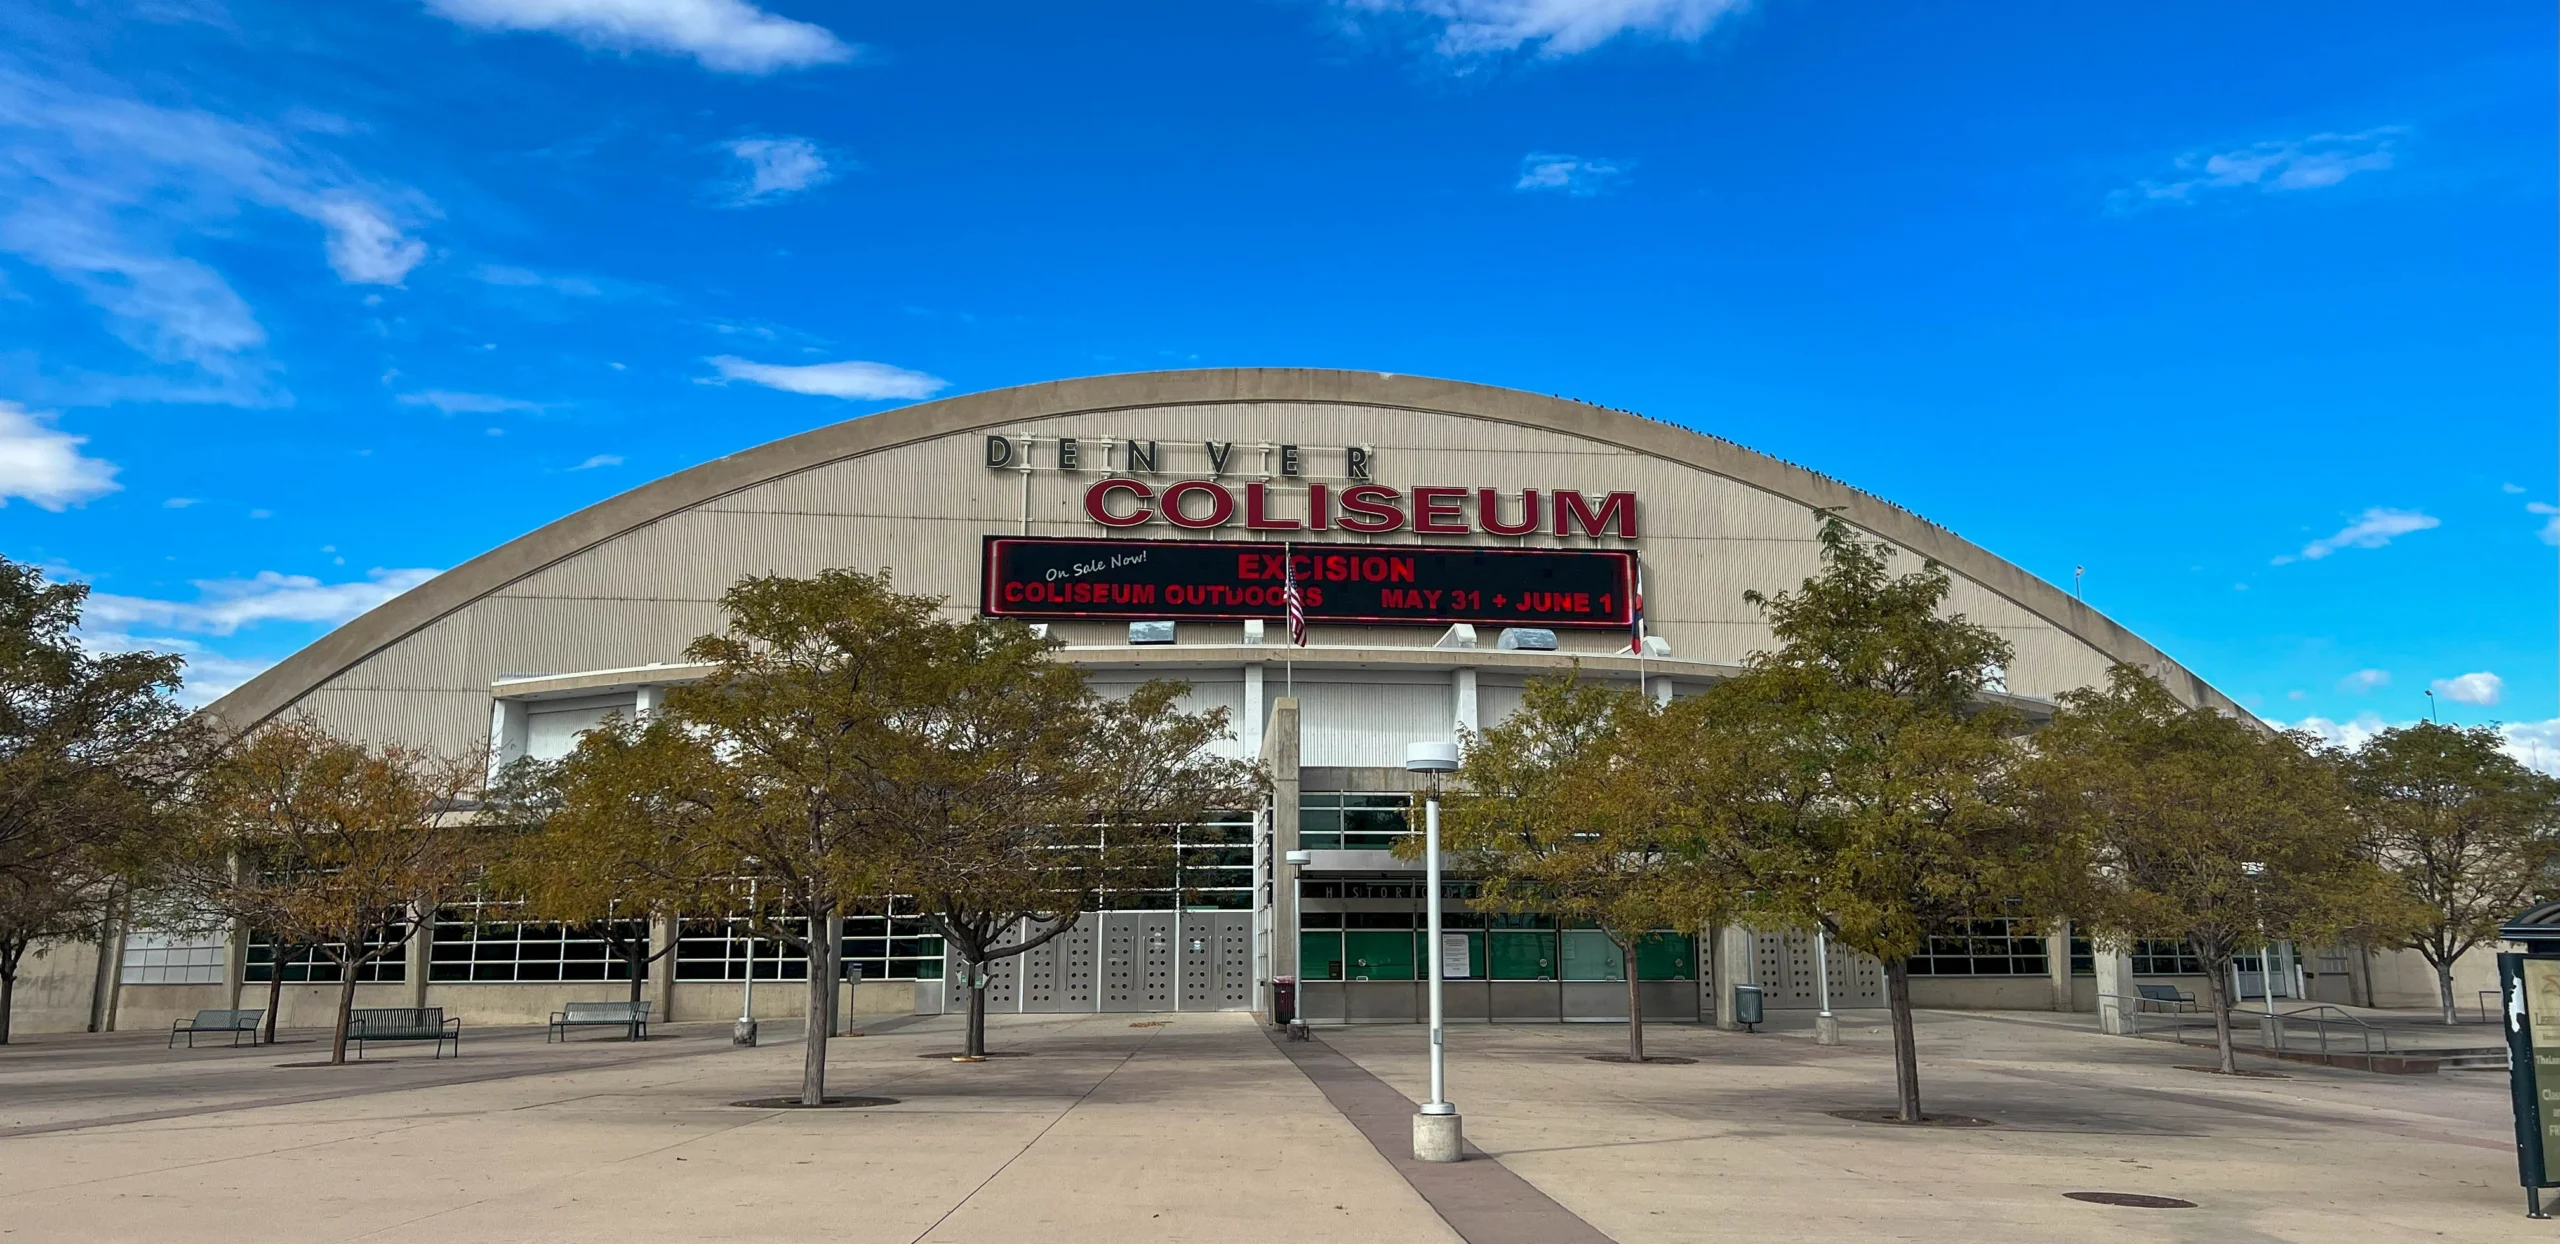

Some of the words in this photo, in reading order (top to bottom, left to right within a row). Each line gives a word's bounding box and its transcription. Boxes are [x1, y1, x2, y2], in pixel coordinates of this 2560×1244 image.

[986, 434, 1369, 479] DENVER
[1084, 477, 1638, 539] COLISEUM
[1046, 568, 1069, 582] On
[1073, 559, 1106, 577] Sale
[1110, 550, 1148, 568] Now!
[1238, 553, 1415, 582] EXCISION
[1004, 581, 1156, 605] COLISEUM
[1381, 588, 1442, 610] MAY
[1451, 590, 1481, 610] 31
[1492, 594, 1507, 608] +
[1516, 591, 1590, 612] JUNE
[1599, 593, 1612, 613] 1
